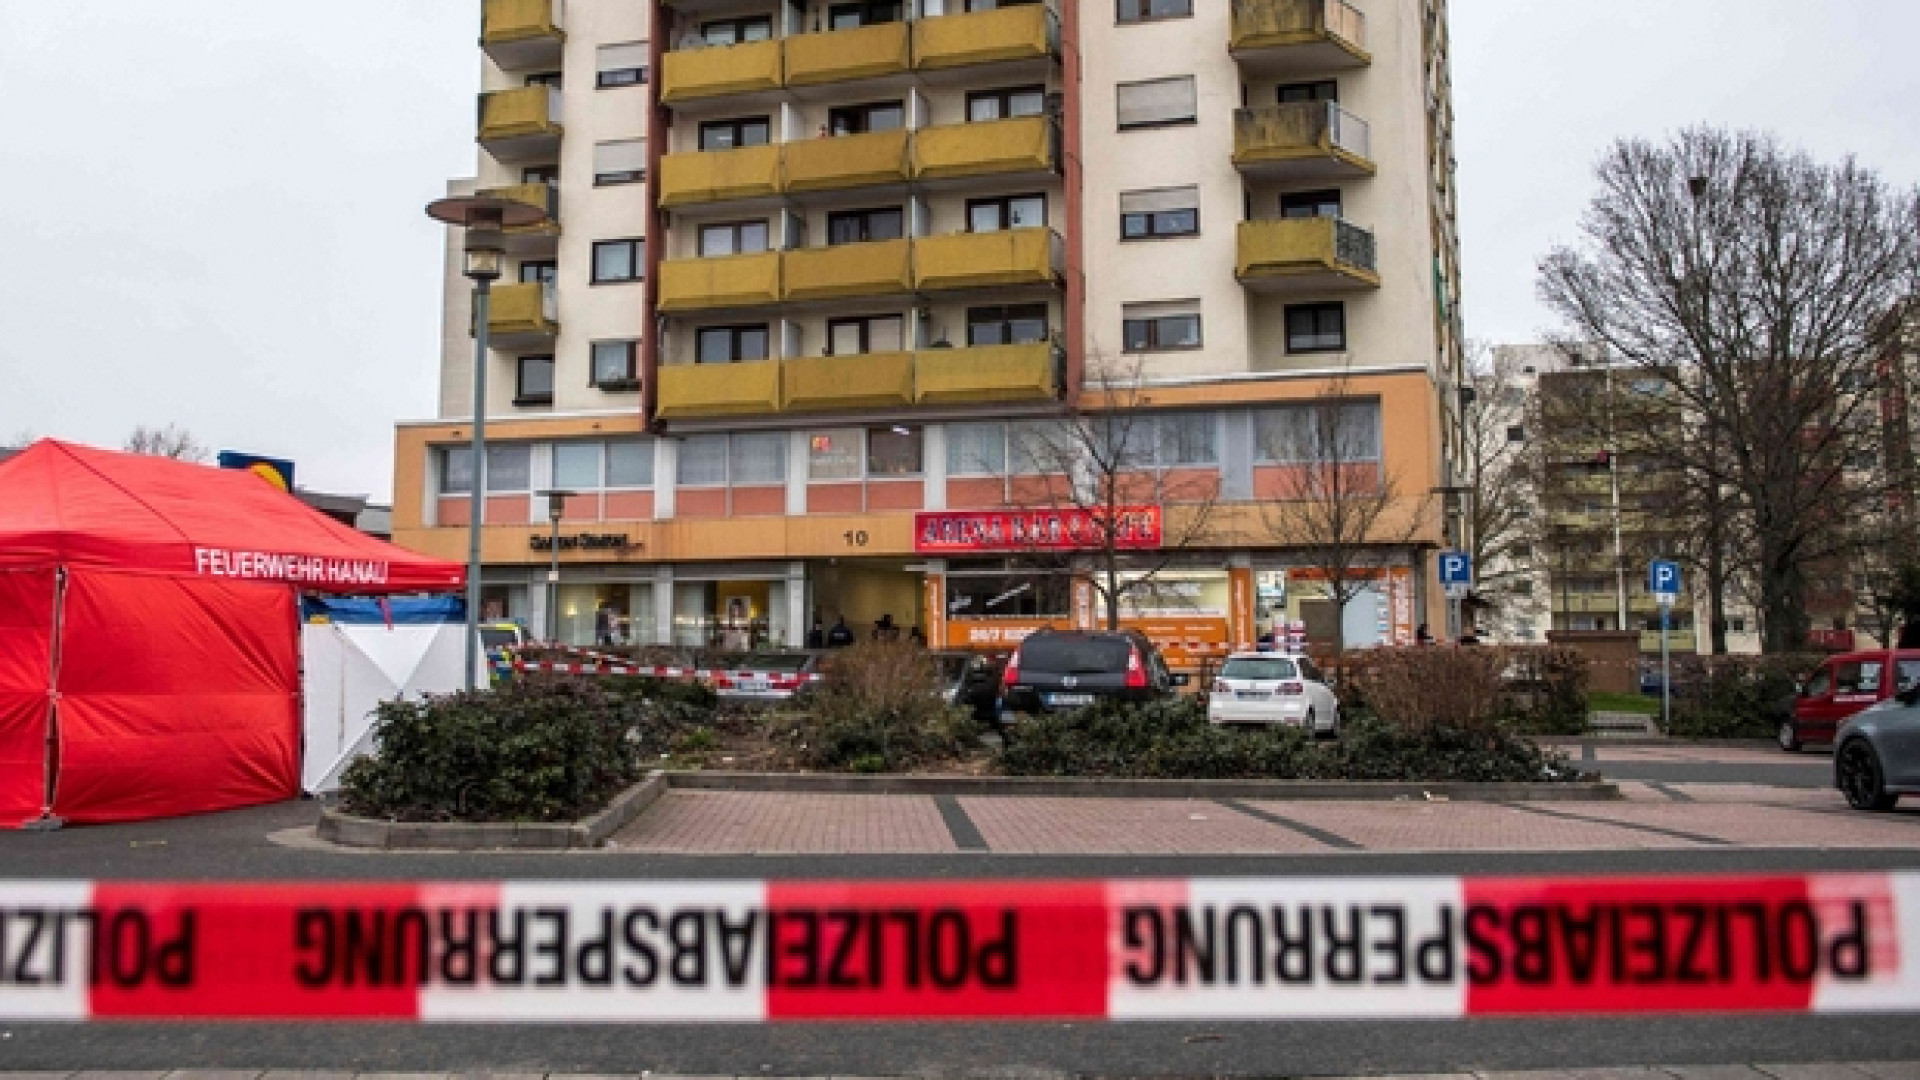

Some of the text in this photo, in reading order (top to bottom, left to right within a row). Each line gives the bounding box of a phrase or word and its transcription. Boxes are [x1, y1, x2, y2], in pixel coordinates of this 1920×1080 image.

[843, 530, 869, 547] 10
[195, 548, 389, 584] FEUERWEHR HANAU
[1445, 556, 1464, 580] P
[1656, 565, 1673, 590] P
[0, 906, 196, 988] POLIZ
[294, 905, 1018, 990] POLIZEIABSPERRUNG
[1123, 900, 1868, 988] POLIZEIABSPERRUNG
